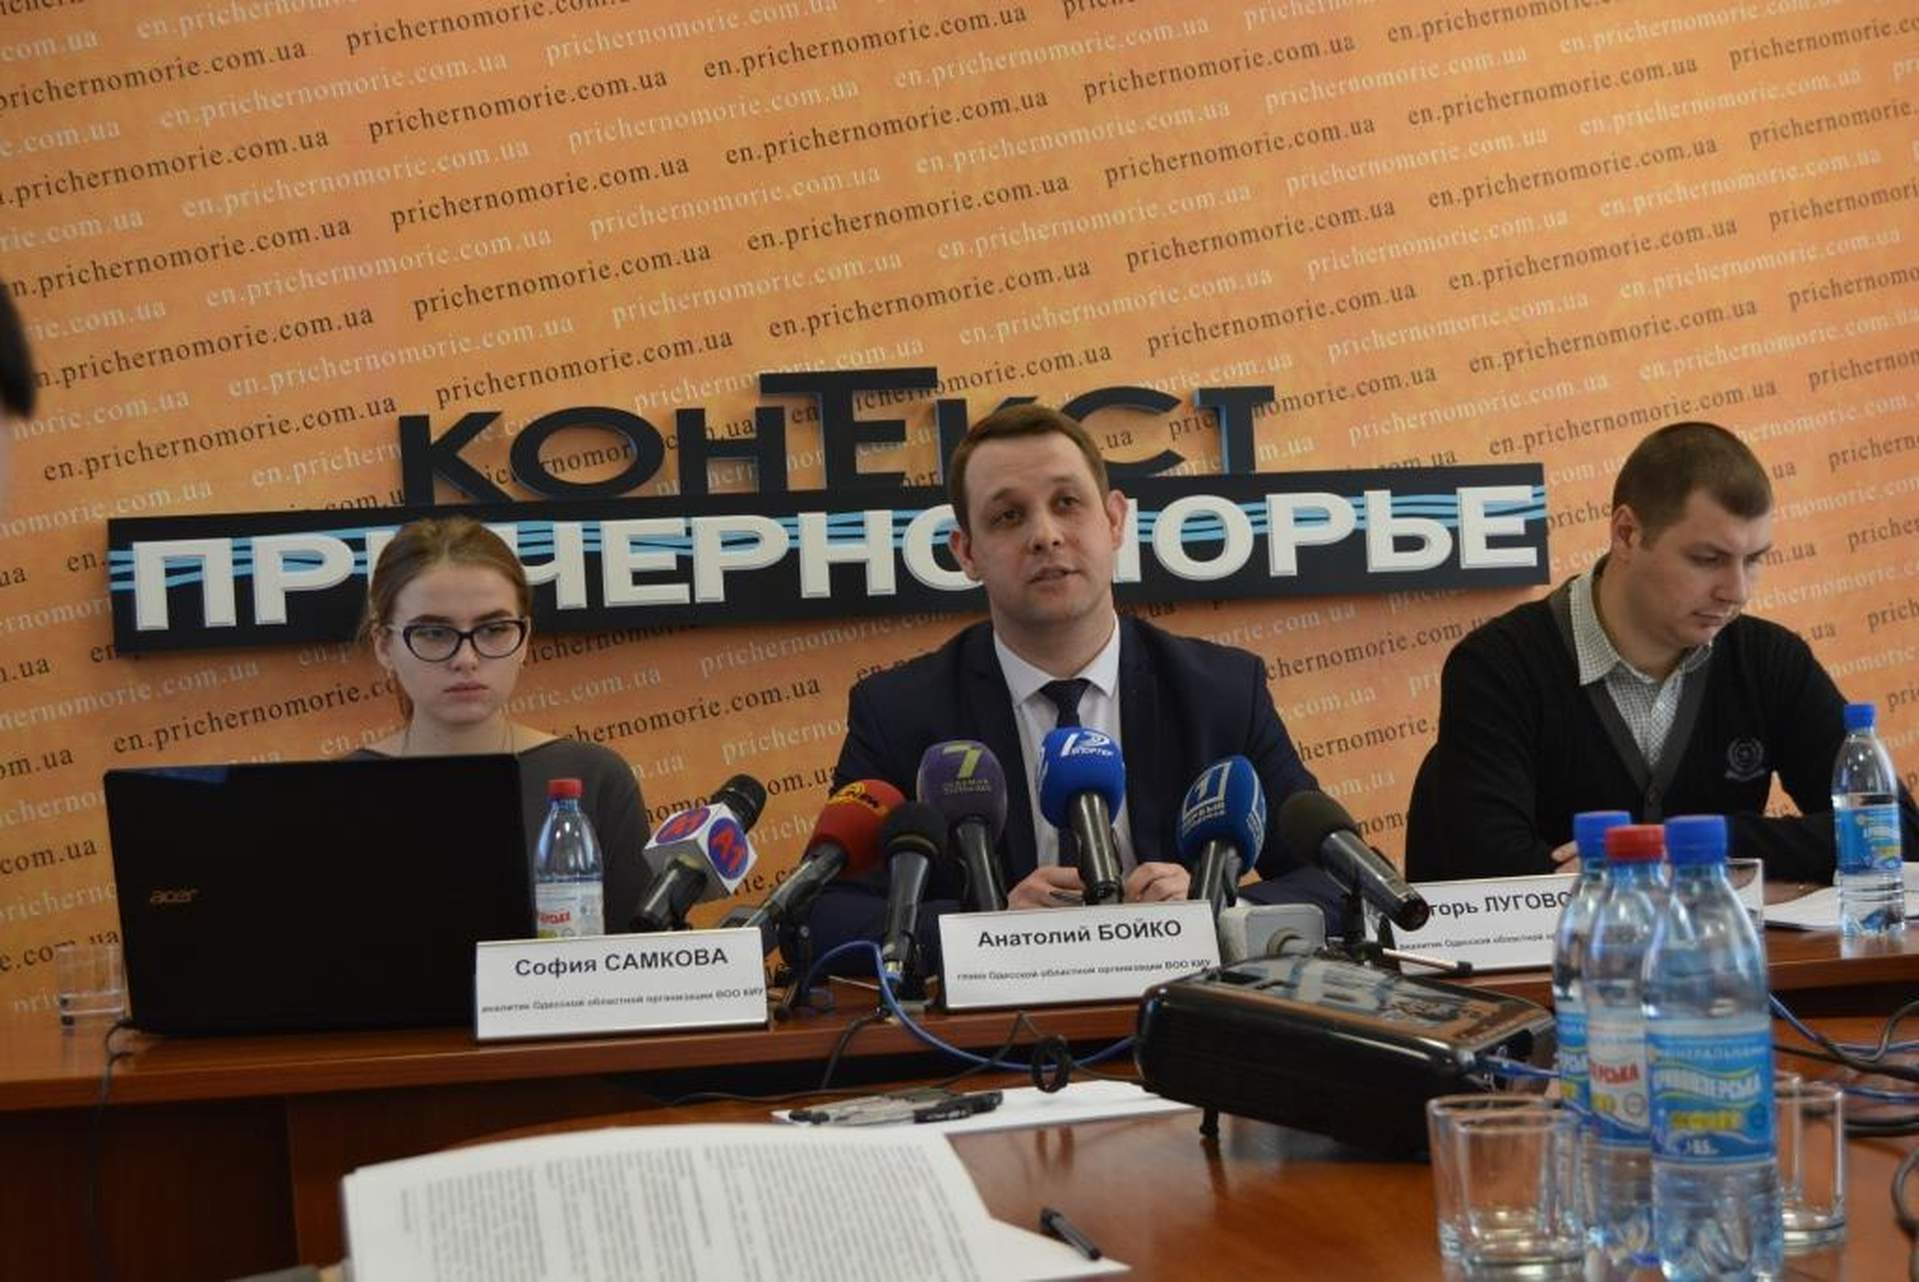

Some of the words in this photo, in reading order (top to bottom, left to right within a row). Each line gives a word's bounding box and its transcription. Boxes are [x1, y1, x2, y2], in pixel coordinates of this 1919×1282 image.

[369, 69, 666, 144] prichernomorie.com.ua
[705, 5, 1027, 77] en.prichernomorie.com.ua
[392, 156, 688, 232] prichernomorie.com.ua
[727, 90, 1048, 164] en.prichernomorie.com.ua
[1085, 35, 1353, 104] prichernomorie.com.ua
[414, 243, 710, 321] prichernomorie.com.ua
[749, 175, 1069, 251] en.prichernomorie.com.ua
[1106, 118, 1374, 189] prichernomorie.com.ua
[1409, 57, 1698, 126] en.prichernomorie.com.ua
[45, 396, 396, 481] en.prichernomorie.com.ua
[436, 330, 732, 410] prichernomorie.com.ua
[771, 259, 1090, 337] en.prichernomorie.com.ua
[1127, 200, 1394, 273] prichernomorie.com.ua
[1429, 138, 1717, 208] en.prichernomorie.com.ua
[1148, 283, 1415, 358] prichernomorie.com.ua
[1450, 218, 1737, 291] en.prichernomorie.com.ua
[1470, 299, 1757, 373] en.prichernomorie.com.ua
[1490, 379, 1777, 456] en.prichernomorie.com.ua
[133, 485, 1537, 631] ПРЧЕРНООРЬЕ
[515, 956, 598, 979] София
[604, 947, 729, 972] САМКОВА
[977, 926, 1091, 948] Анатолий
[1098, 917, 1182, 941] БОЙКО
